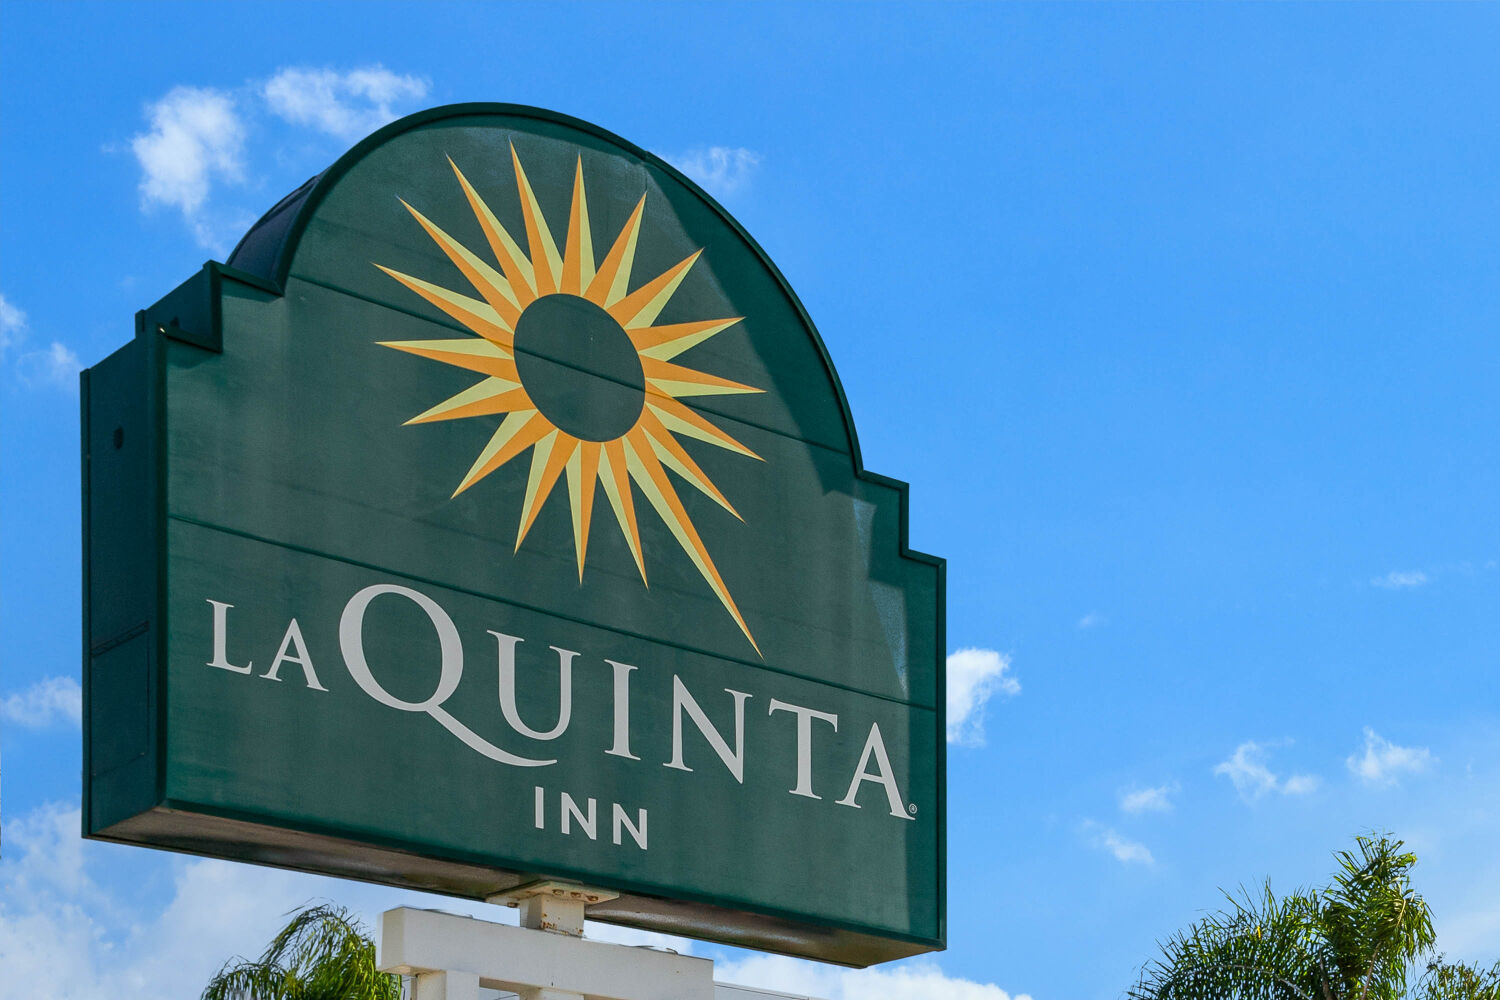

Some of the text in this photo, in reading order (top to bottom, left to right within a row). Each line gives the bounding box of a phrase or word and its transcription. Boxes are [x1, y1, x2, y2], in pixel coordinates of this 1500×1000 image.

[206, 583, 917, 821] LA QUINTA
[534, 786, 649, 851] INN
